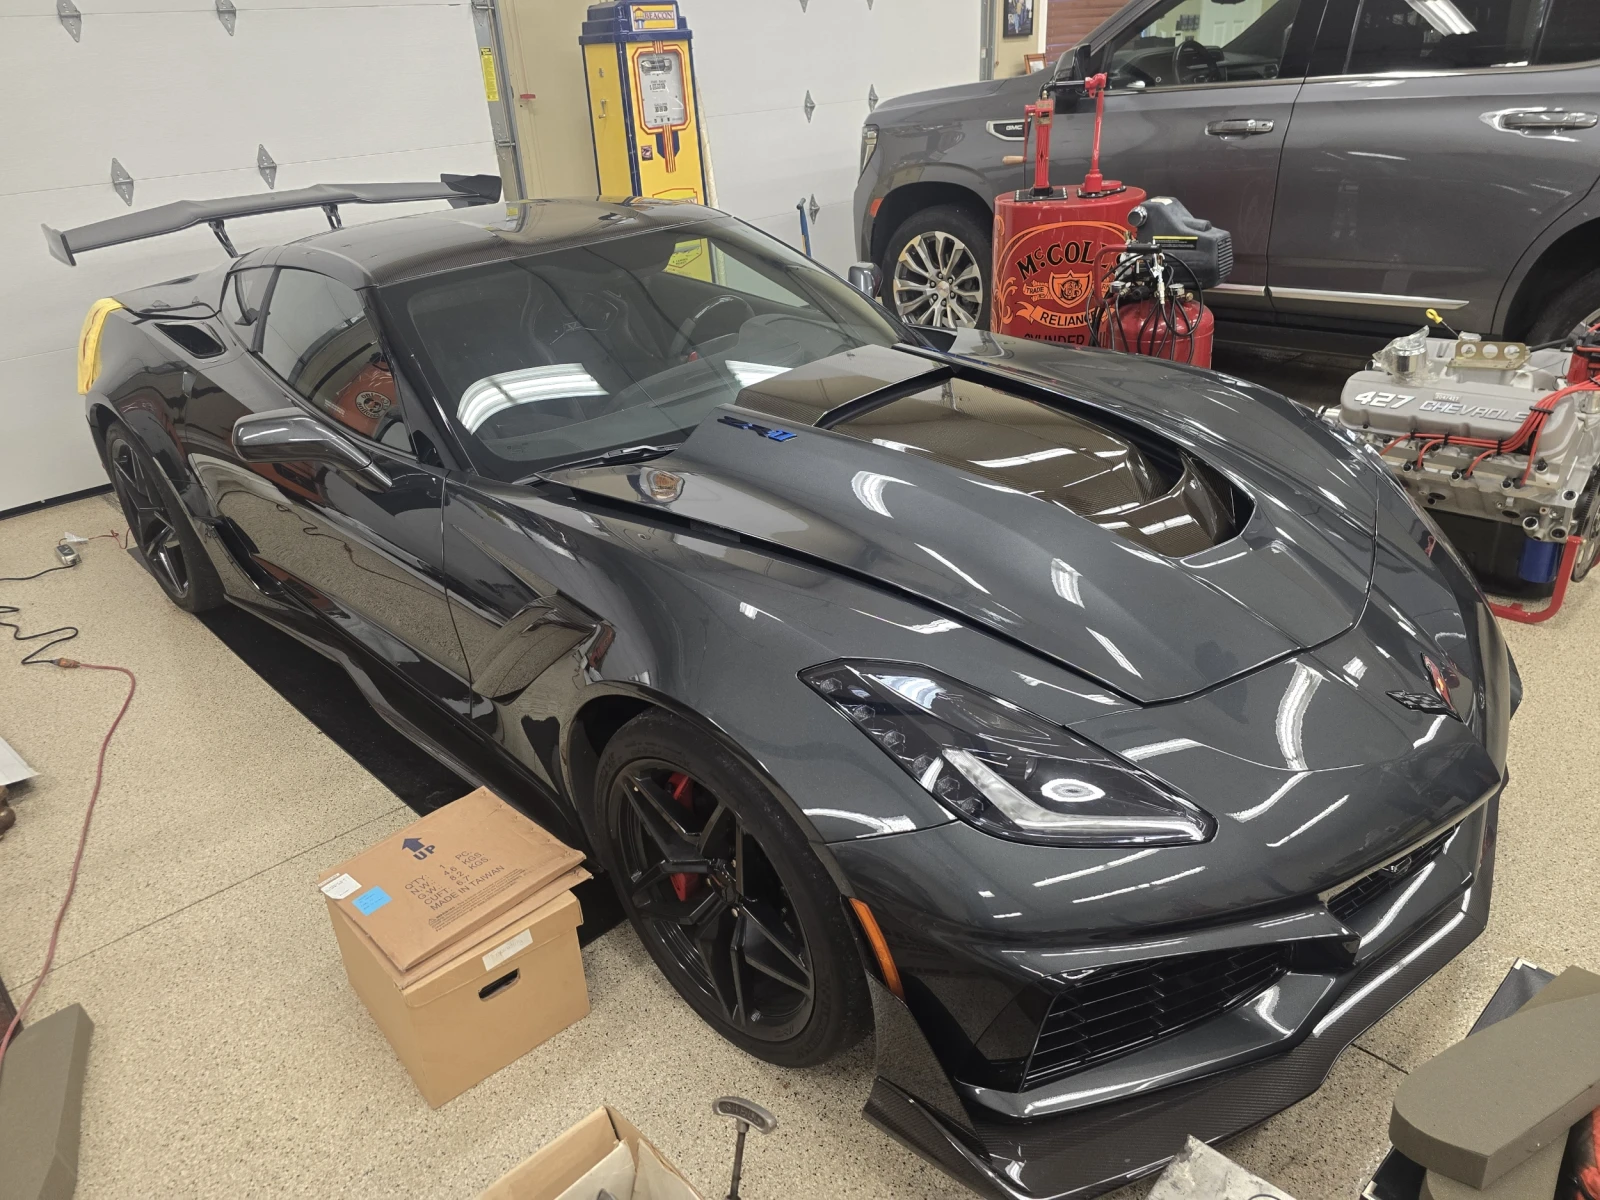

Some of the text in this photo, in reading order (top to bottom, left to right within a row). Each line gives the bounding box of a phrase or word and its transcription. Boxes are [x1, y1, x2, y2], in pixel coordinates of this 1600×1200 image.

[1016, 241, 1108, 280] McCOL
[1026, 286, 1044, 294] TRADE
[1040, 311, 1095, 326] RELIANC
[1354, 391, 1416, 409] 427
[1419, 399, 1529, 423] CHEVROLE
[413, 845, 436, 860] UP
[455, 851, 472, 860] PC.
[461, 852, 485, 865] KGS.
[468, 857, 491, 870] KGS.
[430, 865, 505, 910] MADE IN TAIWAN
